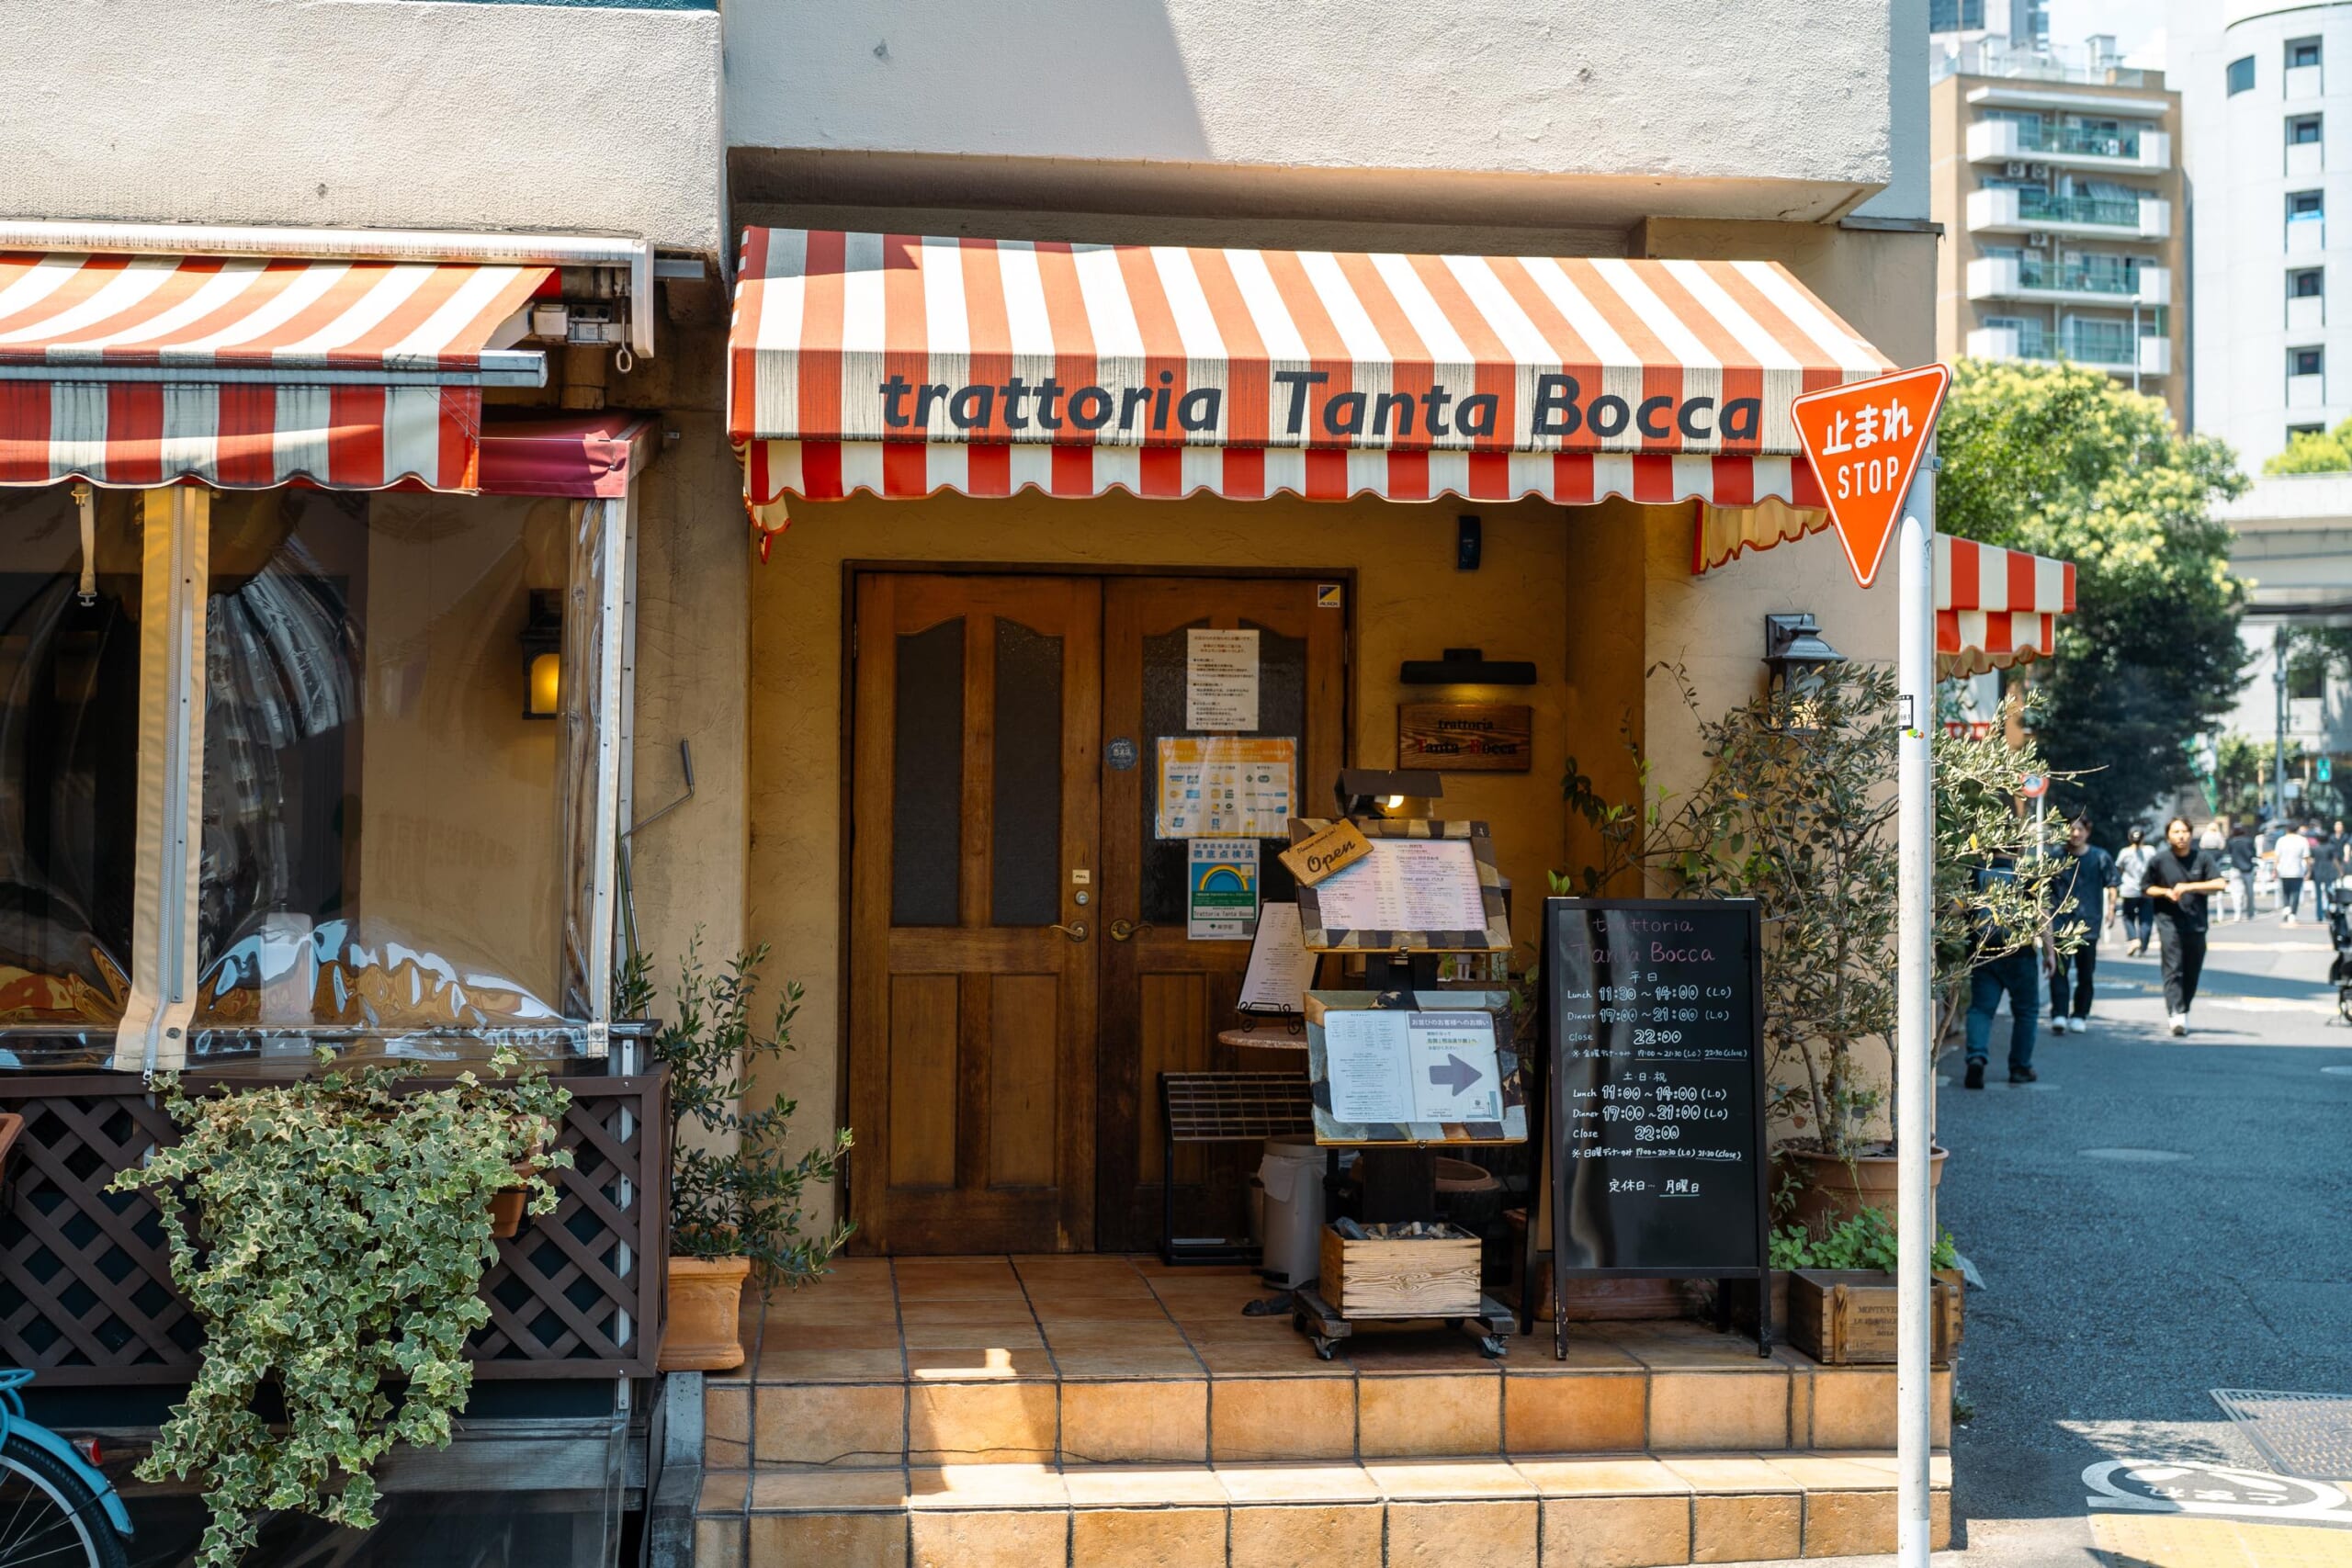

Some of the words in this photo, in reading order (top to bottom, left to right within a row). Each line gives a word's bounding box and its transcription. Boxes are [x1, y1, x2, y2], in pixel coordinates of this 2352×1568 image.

[879, 370, 1222, 431] trattoria
[1273, 371, 1499, 436] Tanta
[1532, 374, 1762, 440] Bocca
[1822, 398, 1913, 457] 止まれ
[1838, 455, 1900, 499] STOP
[1438, 717, 1494, 730] trattoria
[1307, 840, 1356, 874] Open
[1651, 942, 1715, 963] Bocca
[1629, 971, 1657, 983] 平日
[1567, 988, 1592, 999] Lunch
[1567, 1011, 1596, 1021] Dinner
[1633, 1030, 1682, 1044] 22:00
[1573, 1088, 1597, 1098] Lunch
[1573, 1109, 1599, 1118] Dinner
[1572, 1129, 1599, 1138] Close
[1634, 1125, 1679, 1142] 22:00
[1665, 1179, 1700, 1194] 月曜日
[2143, 1484, 2289, 1504] とまれ
